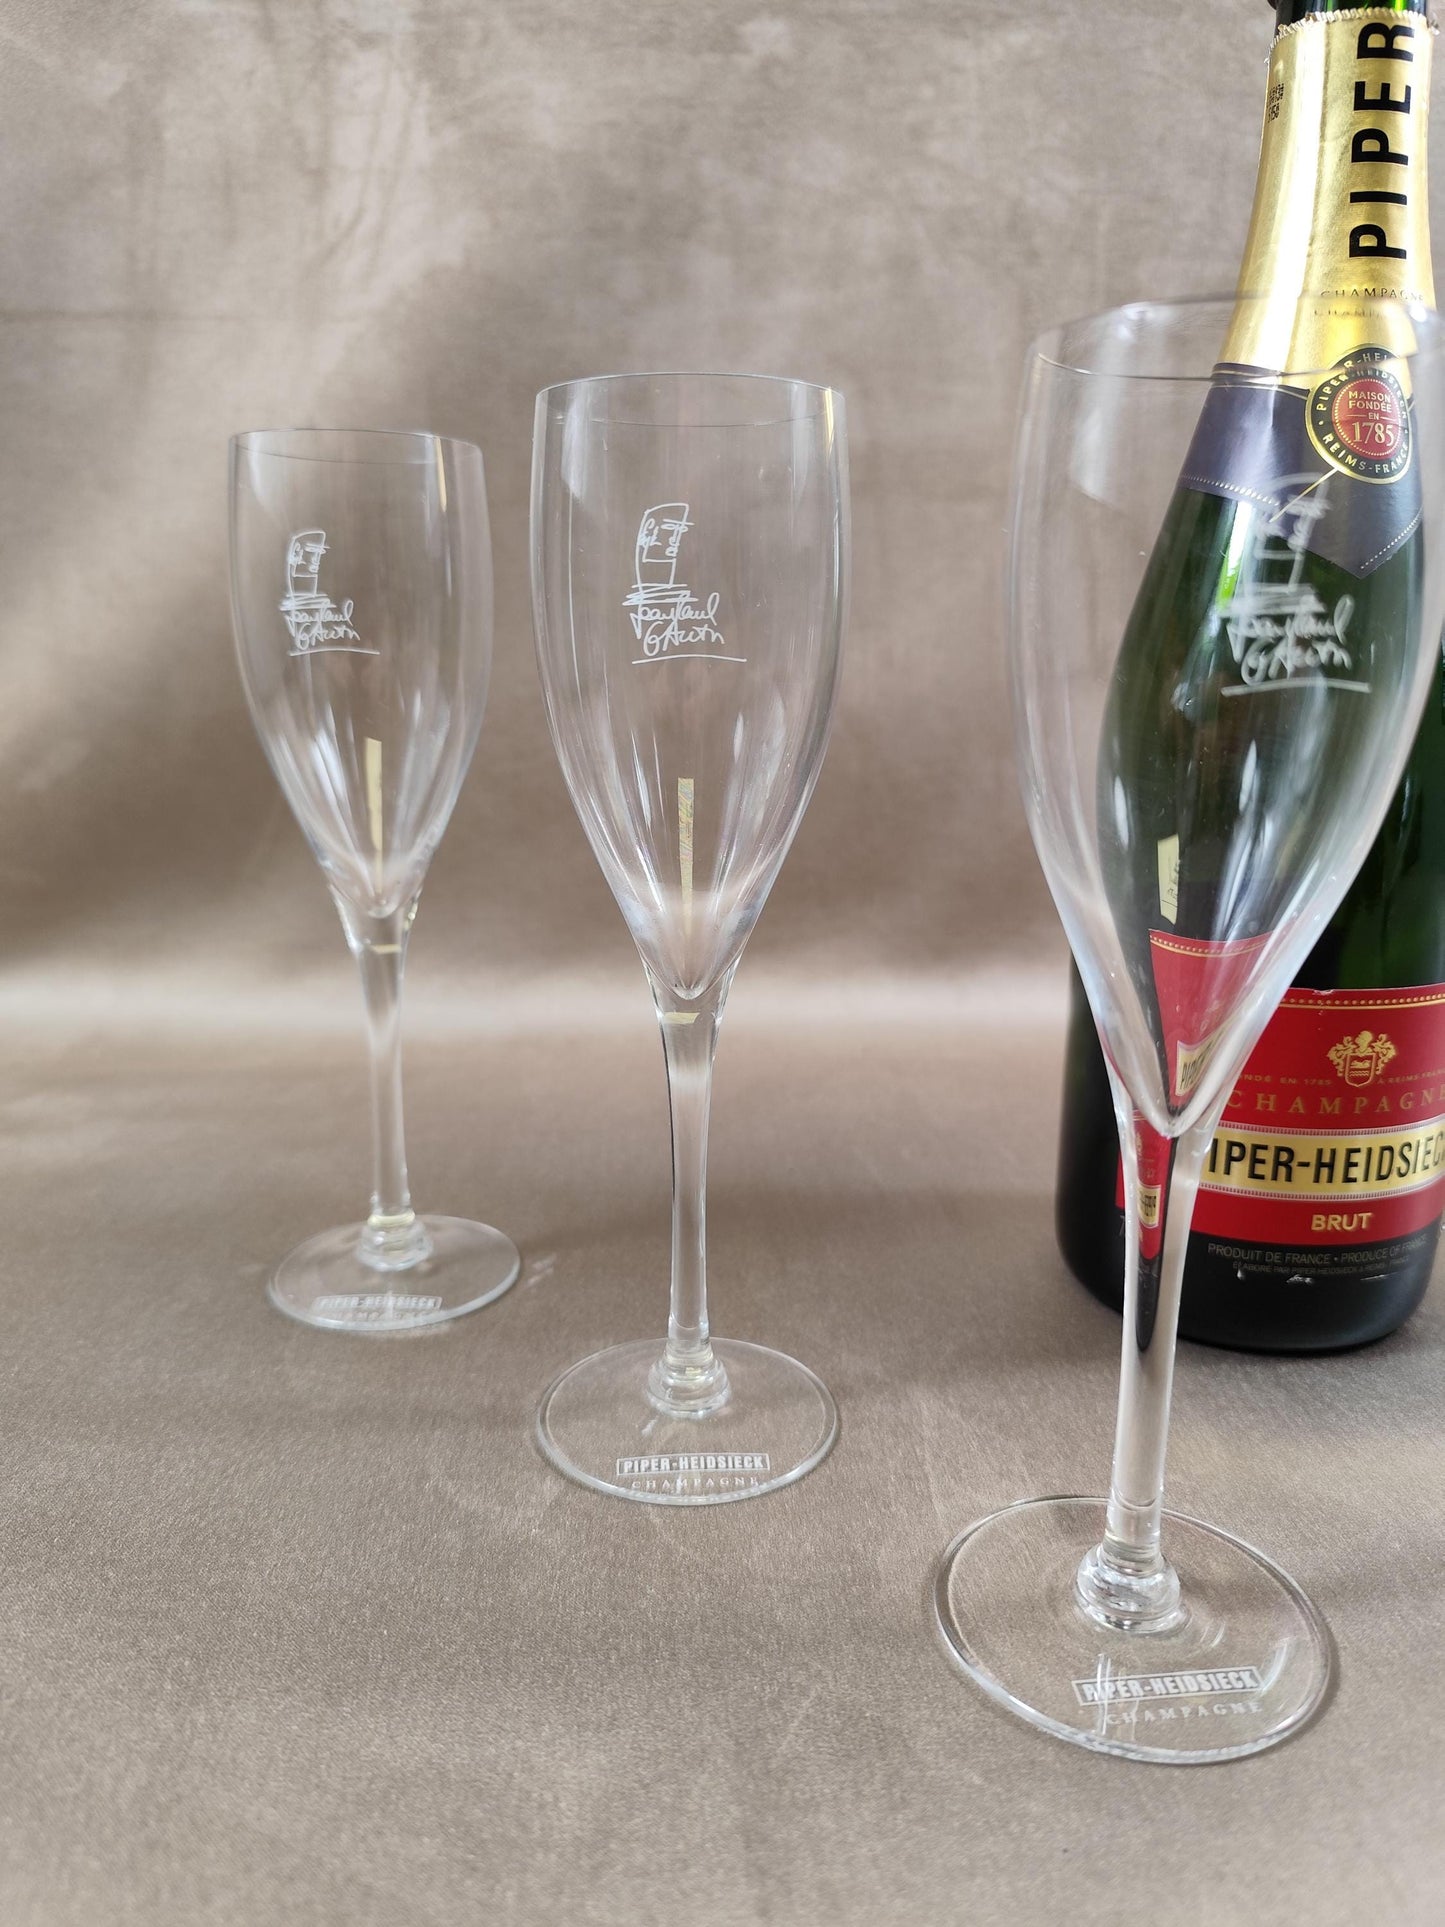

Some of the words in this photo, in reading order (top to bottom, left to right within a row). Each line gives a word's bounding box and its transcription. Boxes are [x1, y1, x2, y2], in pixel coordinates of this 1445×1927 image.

[1349, 22, 1414, 259] PIPER
[1348, 391, 1391, 403] MAISON
[1348, 400, 1392, 413] FONDÉE
[1368, 412, 1380, 420] EN
[1352, 421, 1394, 446] 1785
[1209, 1131, 1445, 1184] IPER-HEIDSIEC
[1311, 1212, 1373, 1231] BRUT
[1208, 1243, 1264, 1260] PRODUIT
[1265, 1251, 1281, 1263] DE
[1285, 1253, 1332, 1265] FRANCE
[1340, 1248, 1388, 1264] PRODUCE
[623, 1455, 764, 1473] PIPER-HEIDSIECK
[631, 1477, 760, 1490] CHAMPAGNE
[1081, 1670, 1258, 1702] PIPER-HEIDSIECK
[1106, 1701, 1264, 1725] CHAMPAGNE
